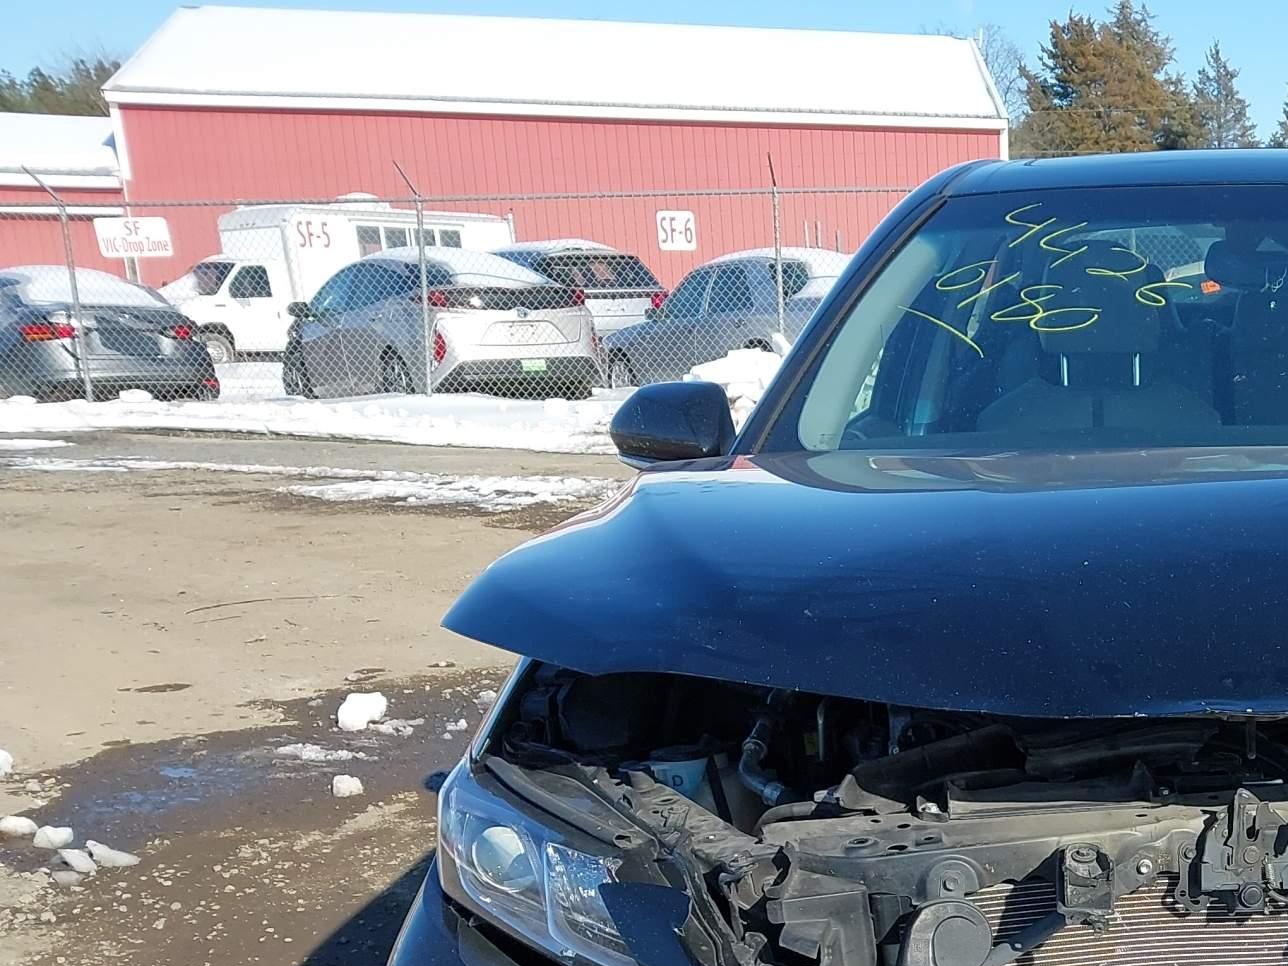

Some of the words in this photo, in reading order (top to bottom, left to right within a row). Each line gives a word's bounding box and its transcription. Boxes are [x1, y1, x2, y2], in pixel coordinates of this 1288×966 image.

[123, 220, 141, 237] SF
[296, 220, 331, 248] SF-5
[660, 216, 693, 244] SF-6
